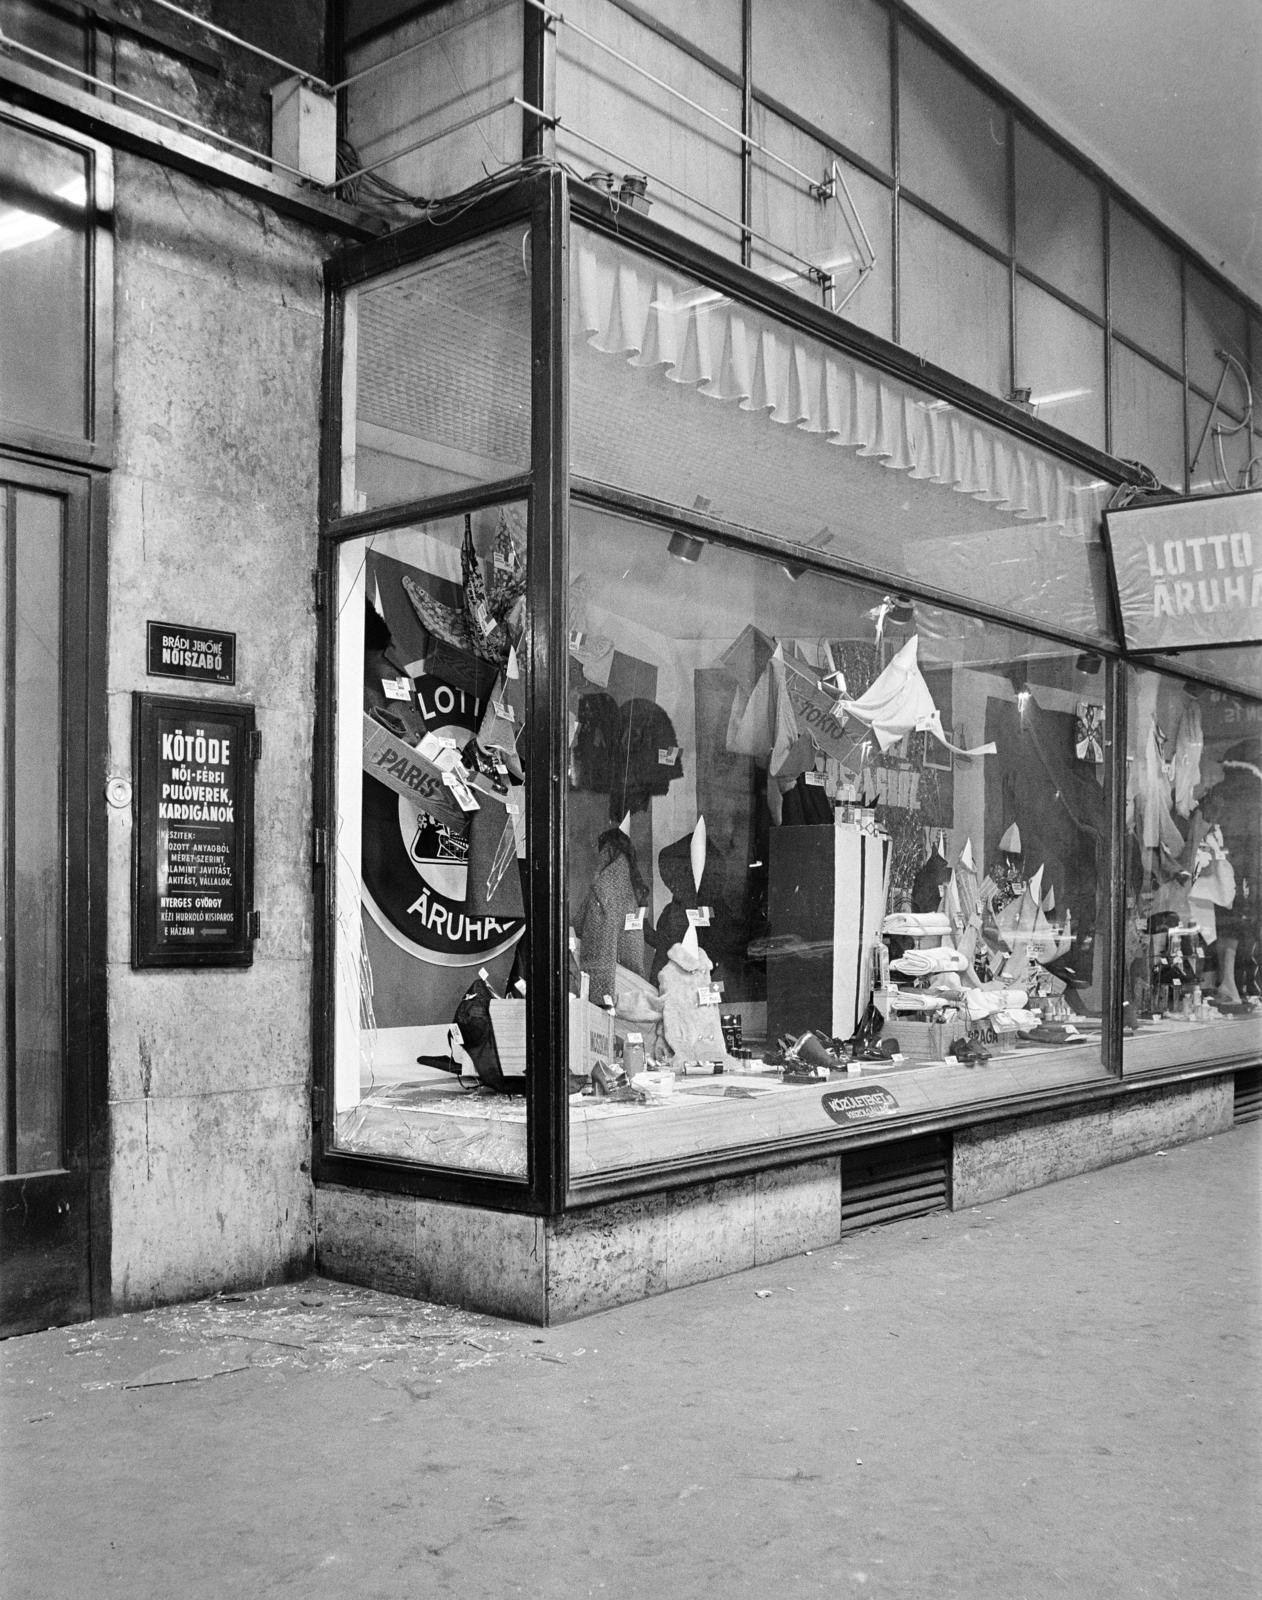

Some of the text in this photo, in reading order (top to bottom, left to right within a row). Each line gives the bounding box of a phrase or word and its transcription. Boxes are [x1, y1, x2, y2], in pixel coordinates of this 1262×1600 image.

[1146, 532, 1253, 577] LOTTO
[162, 635, 190, 650] BRÁDI
[377, 748, 440, 798] PARIS
[162, 782, 233, 806] PULÓVEREK,
[159, 802, 234, 823] KARDIGÁNOK
[163, 843, 230, 854] OZOTT ANYAGBÓL
[160, 896, 222, 908] NYERGES GYÖRGY
[161, 910, 234, 922] KÉZI HURKOLÓ KISIPAROS
[164, 924, 195, 936] E HÁZBAN
